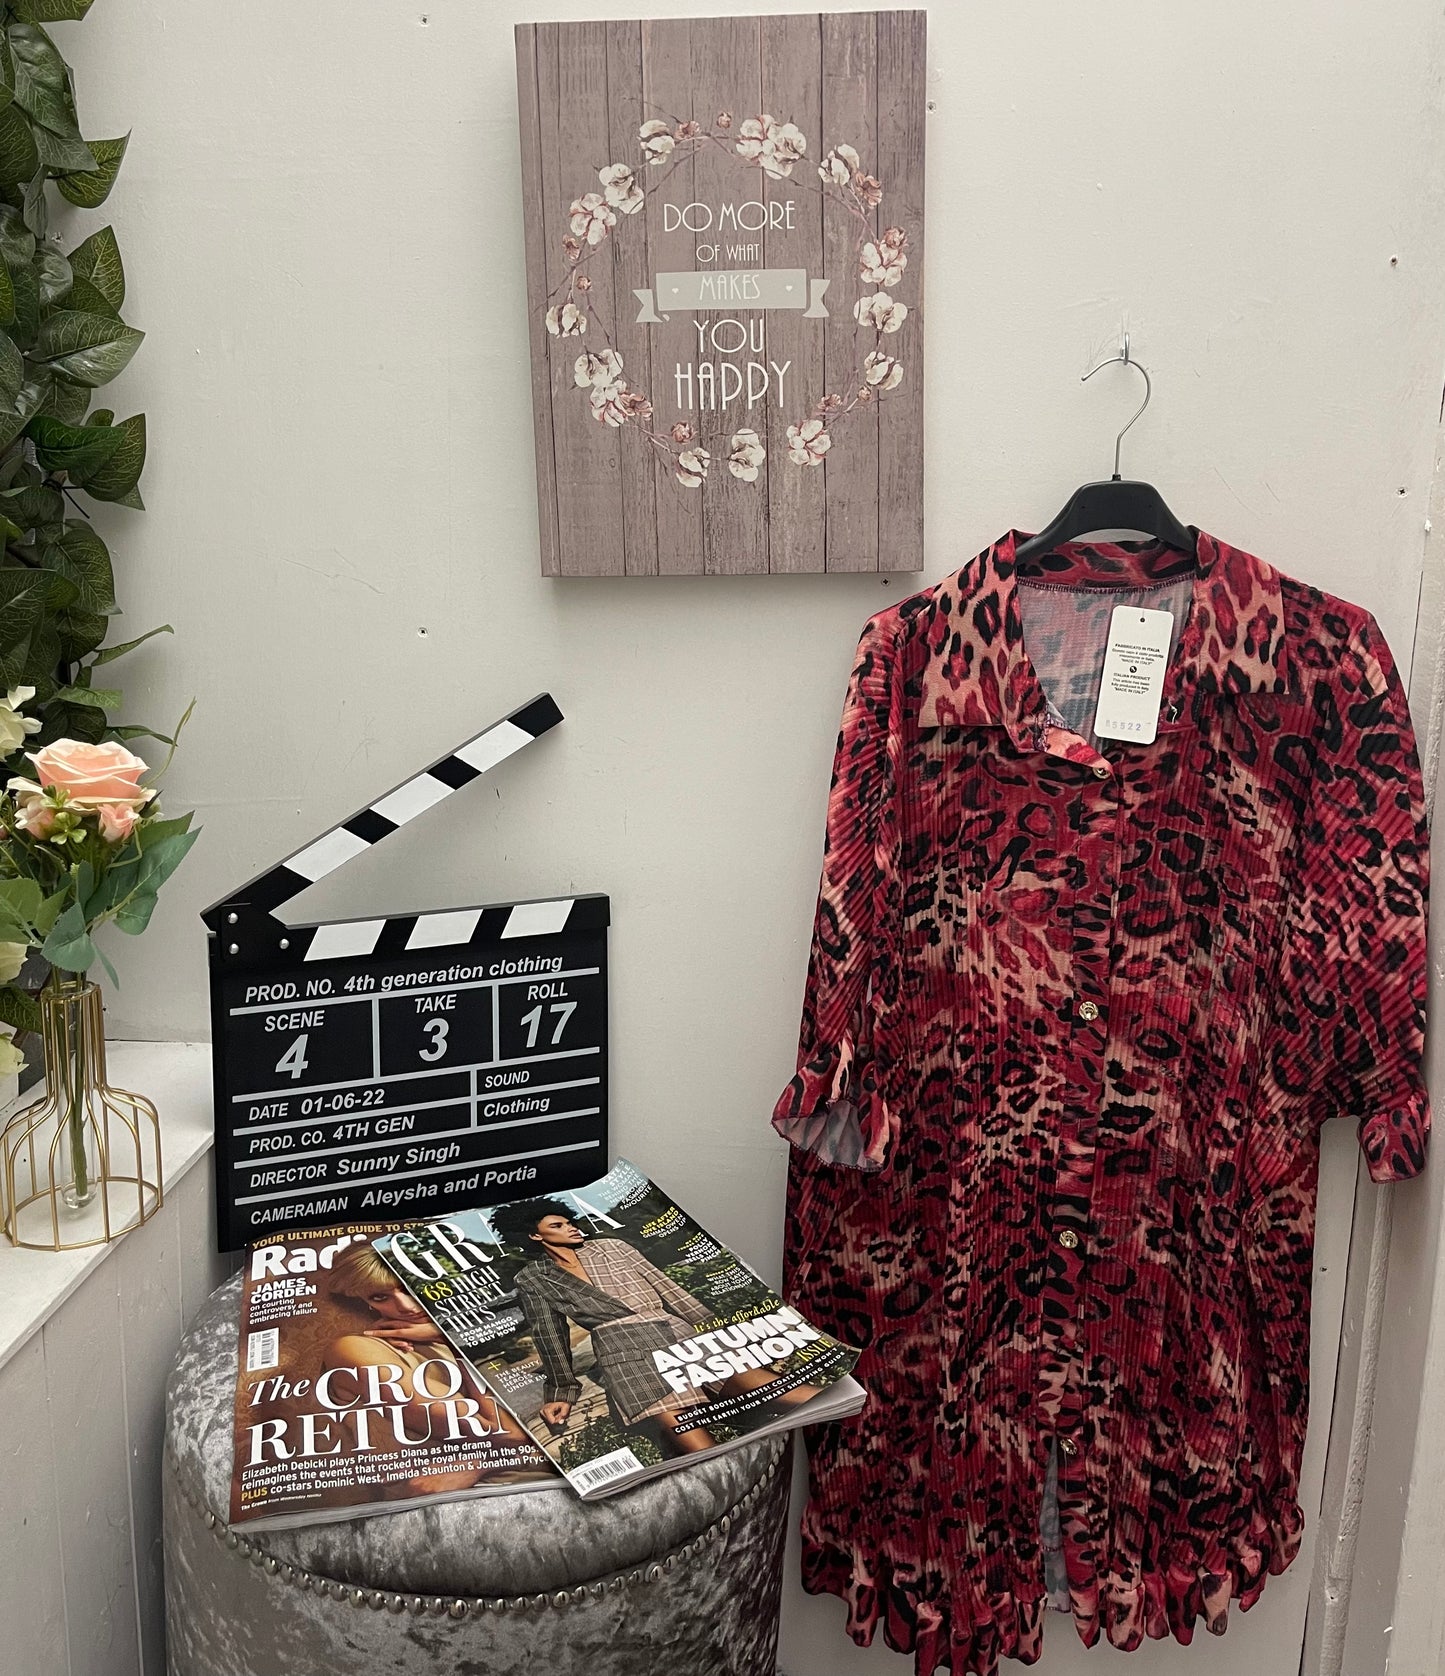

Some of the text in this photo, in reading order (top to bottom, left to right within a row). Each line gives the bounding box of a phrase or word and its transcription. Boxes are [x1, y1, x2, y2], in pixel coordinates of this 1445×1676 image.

[664, 201, 795, 232] DO MORE
[696, 244, 759, 262] OF WHAT
[700, 274, 760, 300] MAKES
[693, 319, 764, 353] YOU
[674, 361, 791, 410] HAPPY
[246, 956, 563, 1003] PROD. NO. 4th generation clothing
[528, 982, 568, 1000] ROLL
[415, 994, 457, 1013] TAKE
[265, 1010, 325, 1032] SCENE
[521, 1002, 577, 1048] 17
[419, 1018, 449, 1062] 3
[275, 1034, 308, 1079] 4
[485, 1071, 529, 1088] SOUND
[249, 1089, 385, 1120] DATE 01-06-22
[484, 1098, 550, 1117] Clothing
[250, 1115, 415, 1153] PROD. CO. 4TH GEN
[250, 1143, 460, 1187] DIRECTOR Sunny Singh
[610, 1164, 630, 1186] STYLE
[251, 1166, 537, 1224] CAMERAMAN Aleysha and Portia
[620, 1185, 652, 1210] FAVOURITE
[622, 1182, 648, 1204] FASHION
[626, 1178, 644, 1195] ROYAL
[640, 1210, 679, 1235] LOVE ISLAND
[643, 1206, 675, 1229] LIFE AFTER
[666, 1214, 682, 1229] OWEN
[679, 1218, 686, 1226] UP
[252, 1234, 284, 1249] YOUR
[288, 1228, 344, 1240] ULTIMATE
[347, 1225, 382, 1234] GUIDE
[385, 1224, 400, 1232] TO
[689, 1237, 707, 1251] POLLY
[701, 1249, 721, 1262] PINCH
[704, 1245, 717, 1256] THE
[251, 1278, 306, 1294] JAMES
[423, 1265, 500, 1300] 68 HIGH
[732, 1275, 748, 1284] YOUR
[251, 1285, 316, 1304] CORDEN
[262, 1299, 294, 1308] courting
[435, 1281, 505, 1318] STREET
[250, 1303, 296, 1317] controversy
[250, 1311, 290, 1324] embracing
[446, 1305, 496, 1332] HITS
[694, 1299, 780, 1333] It's the affordable
[460, 1316, 512, 1338] FROM MANGO
[480, 1334, 495, 1343] BUY
[497, 1327, 516, 1337] NOW
[497, 1320, 518, 1331] WHAT
[652, 1306, 800, 1373] AUTUMN
[795, 1337, 834, 1362] ISSUE
[495, 1360, 539, 1379] THE BEAUTY
[661, 1322, 821, 1394] FASHION
[247, 1375, 310, 1407] The
[503, 1374, 533, 1388] HEROES
[507, 1379, 534, 1392] UNDER
[675, 1351, 845, 1434] COST THE EARTH! YOUR SMART SHOPPING GUIDE
[677, 1407, 707, 1422] BUDGET
[709, 1396, 736, 1411] BOOTS!
[737, 1392, 745, 1401] IT
[772, 1374, 795, 1388] COATS
[795, 1364, 814, 1378] THAT
[814, 1348, 838, 1367] WON'T
[242, 1441, 492, 1481] Elizabeth Debicki plays Princess Diana as the drama
[242, 1474, 297, 1491] reimagines
[300, 1470, 316, 1479] the
[320, 1467, 352, 1477] events
[355, 1463, 375, 1474] that
[378, 1458, 412, 1471] rocked
[414, 1456, 429, 1466] the
[432, 1452, 456, 1464] royal
[459, 1449, 487, 1461] family
[490, 1447, 499, 1457] in
[501, 1447, 516, 1457] the
[241, 1487, 267, 1501] PLUS
[270, 1481, 312, 1494] co-stars
[315, 1477, 354, 1489] Dominic
[358, 1474, 384, 1484] West,
[387, 1468, 419, 1481] Imelda
[422, 1464, 465, 1476] Staunton
[467, 1461, 474, 1470] &
[477, 1456, 521, 1469] Jonathan
